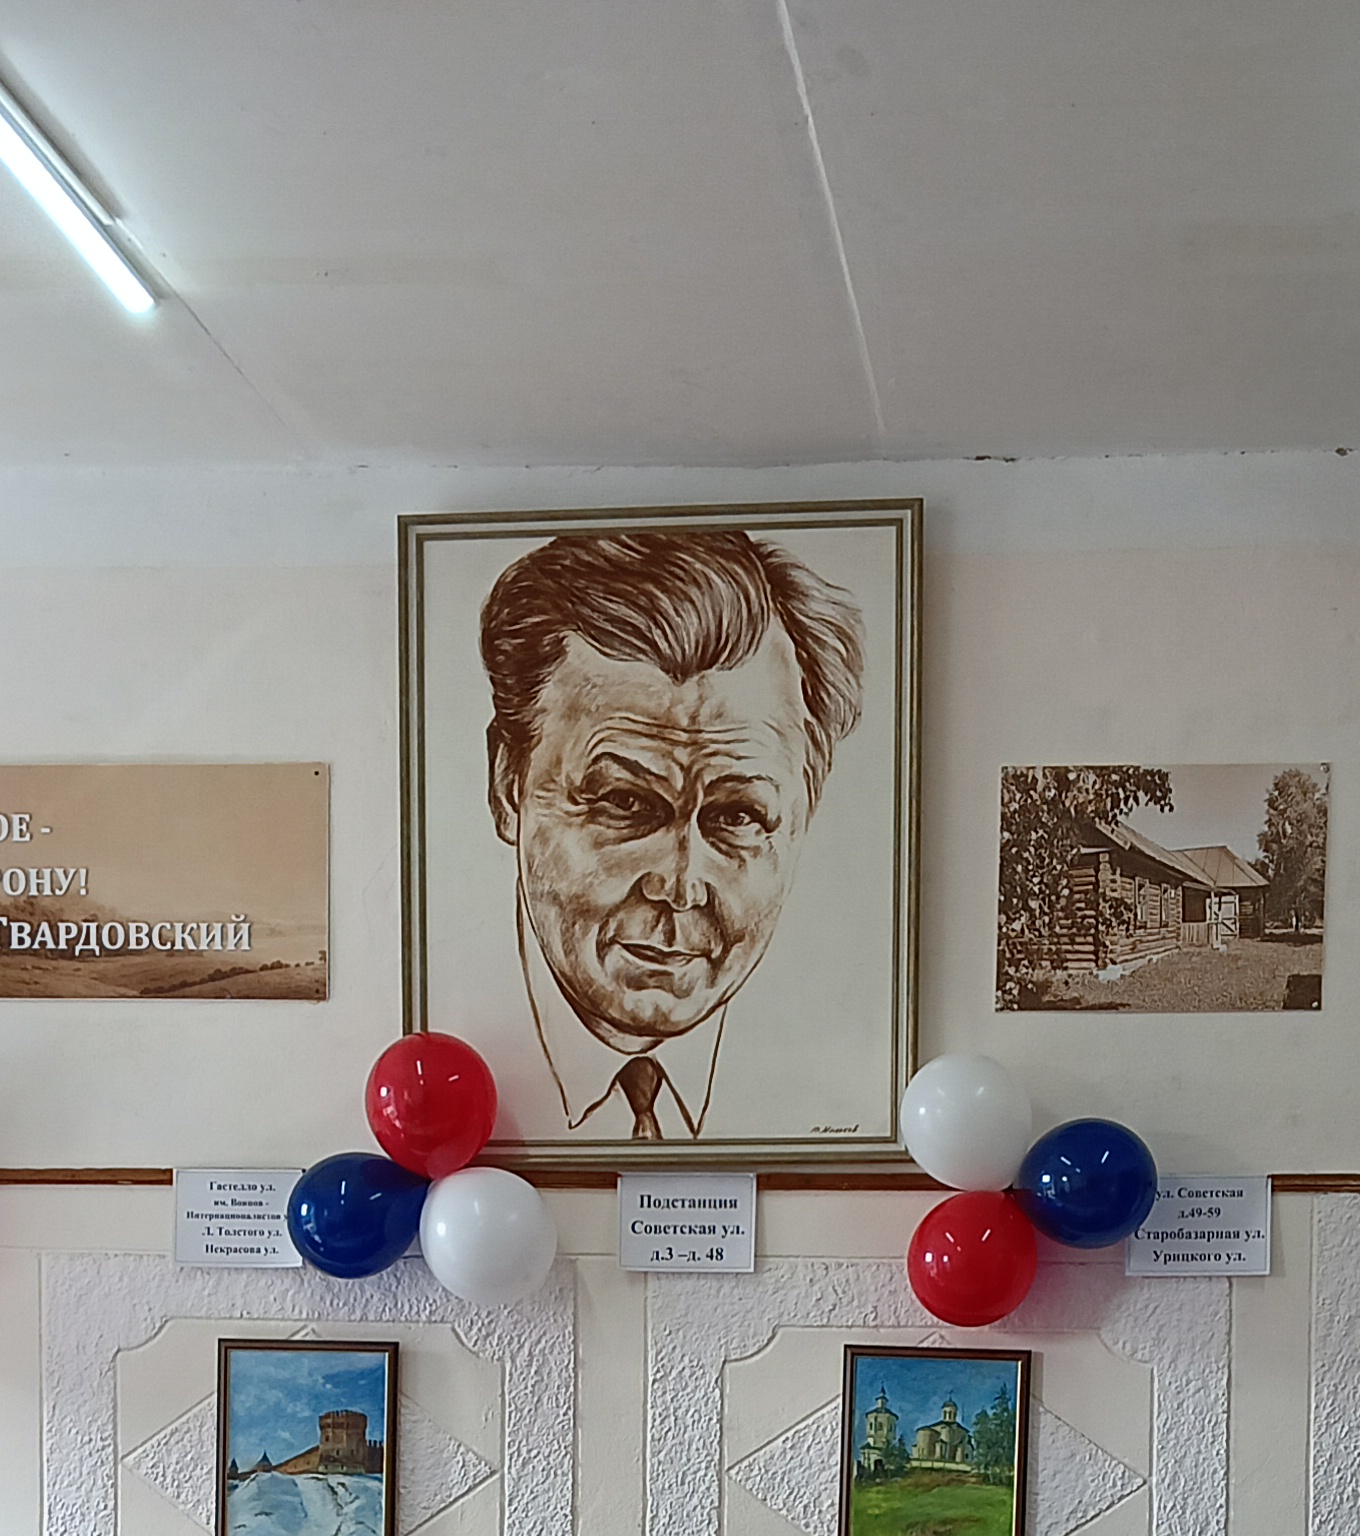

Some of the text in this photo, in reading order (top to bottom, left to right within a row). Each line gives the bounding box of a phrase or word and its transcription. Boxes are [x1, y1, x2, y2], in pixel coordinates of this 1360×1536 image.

[209, 1181, 276, 1194] Гастелло ул.
[1177, 1187, 1244, 1199] Советская
[639, 1194, 738, 1210] Подстанция
[1177, 1207, 1221, 1219] д.49-59
[217, 1226, 265, 1237] Толстого
[631, 1220, 745, 1239] Советская ул.
[1134, 1228, 1265, 1243] Старобазарная ул.
[205, 1244, 261, 1256] Некрасова
[650, 1247, 673, 1262] д.3
[705, 1247, 724, 1261] 48
[1153, 1250, 1246, 1265] Урицкого ул.
